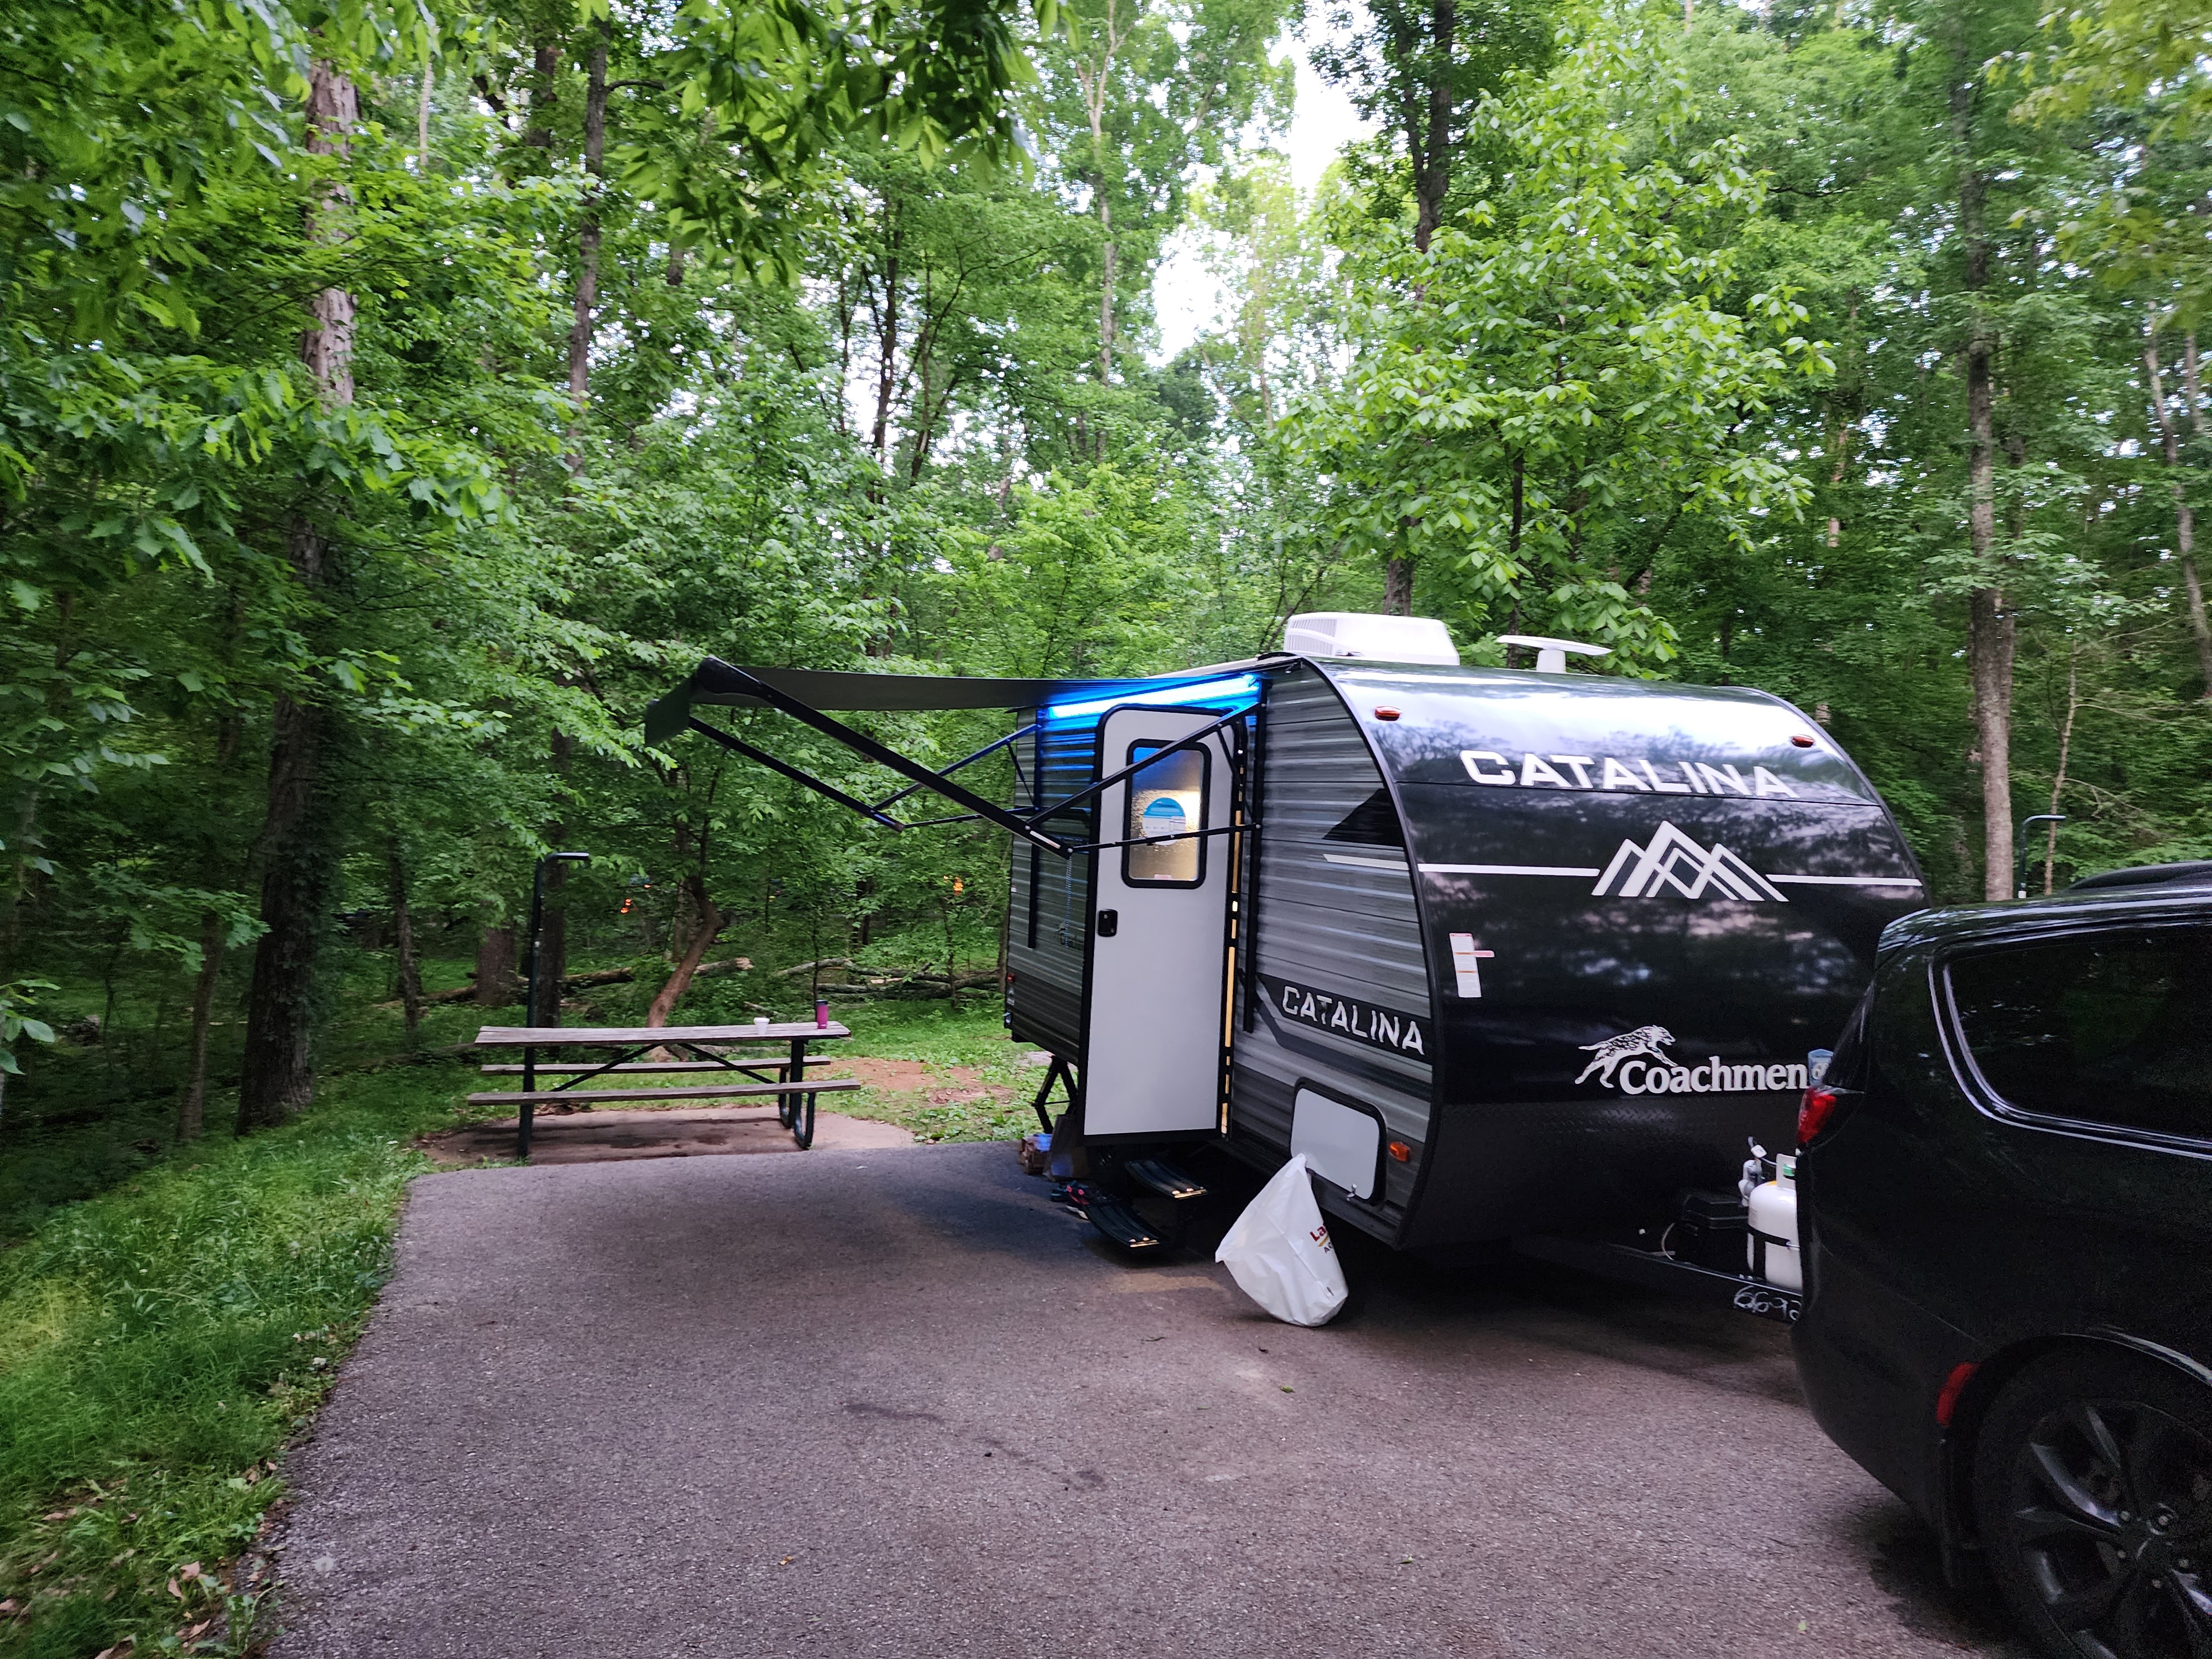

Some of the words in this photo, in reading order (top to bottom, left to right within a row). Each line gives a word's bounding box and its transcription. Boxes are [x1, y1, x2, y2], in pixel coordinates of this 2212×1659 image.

[1459, 750, 1800, 798] CATALINA
[1282, 986, 1425, 1055] CATALINA
[1619, 1056, 1809, 1094] Coachmen
[1310, 1223, 1327, 1242] La
